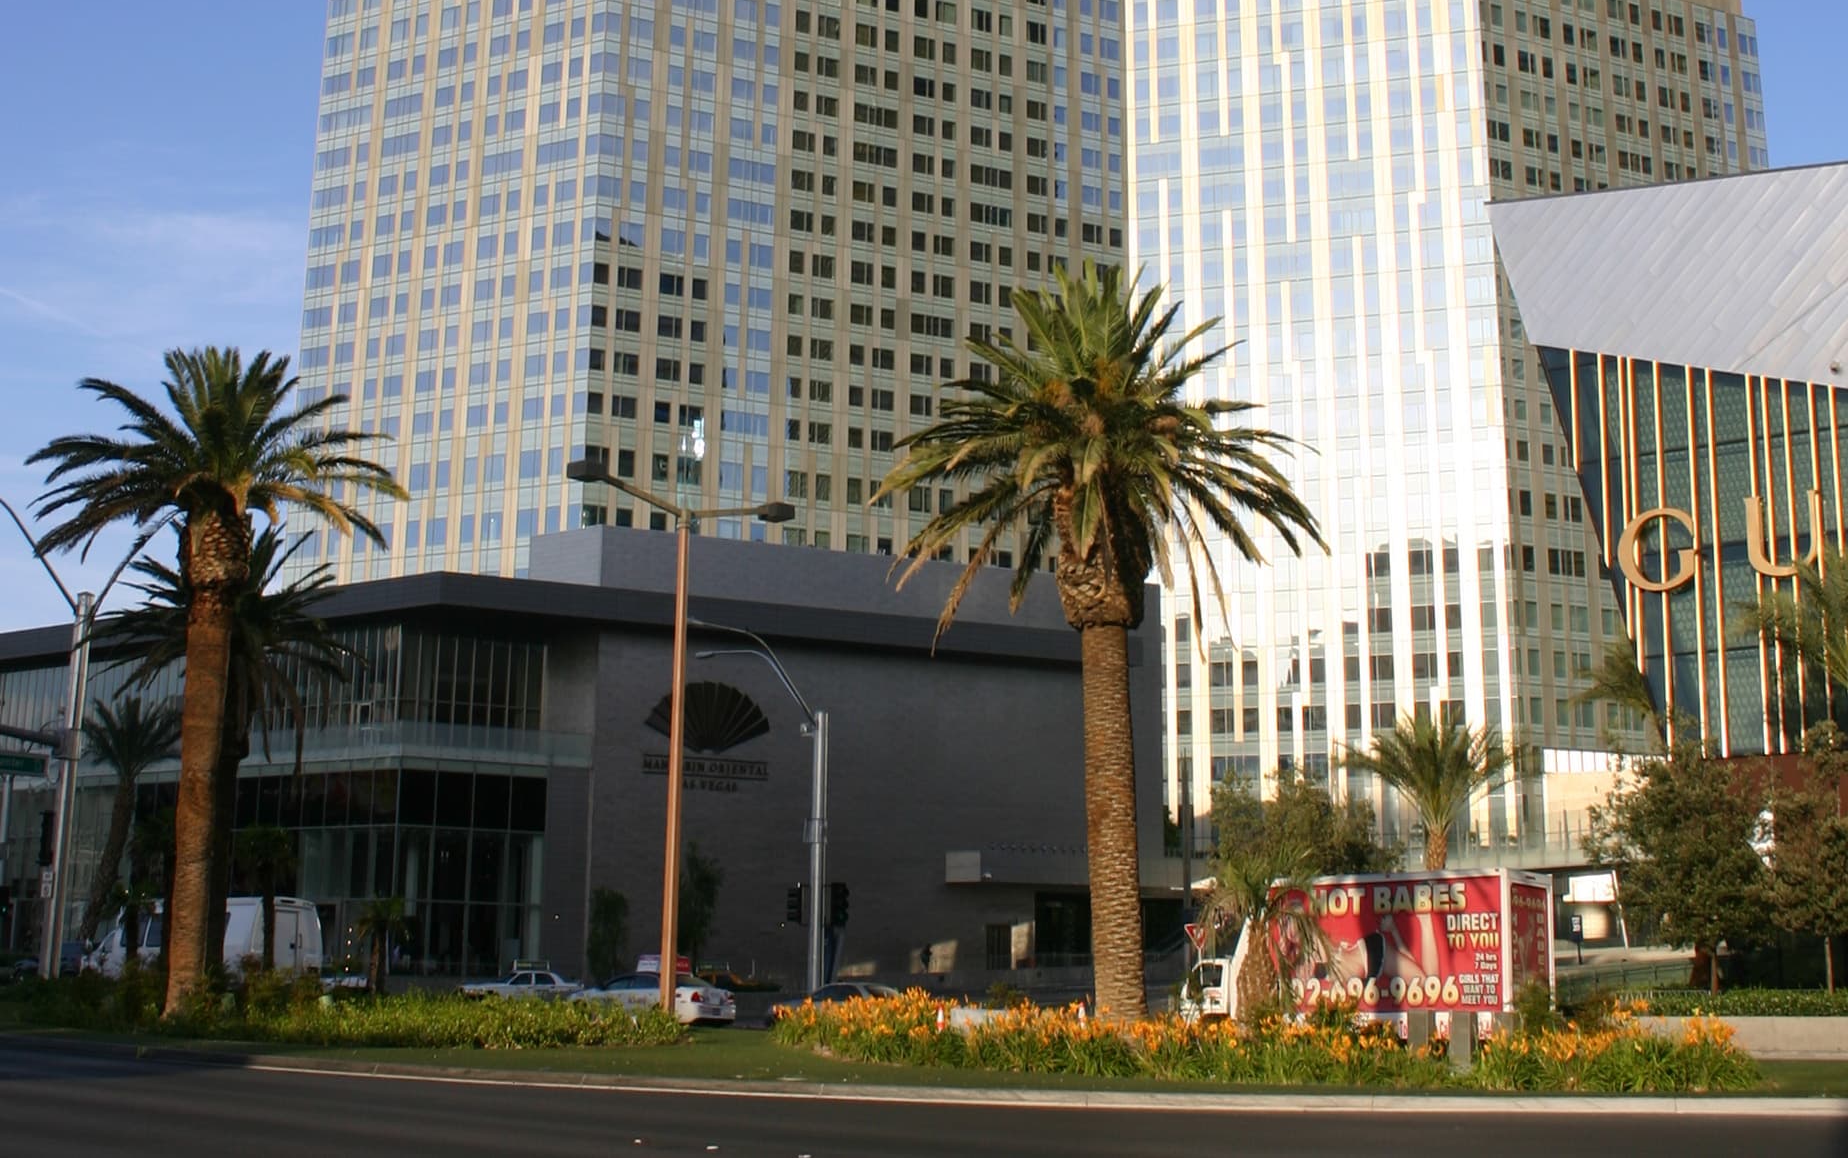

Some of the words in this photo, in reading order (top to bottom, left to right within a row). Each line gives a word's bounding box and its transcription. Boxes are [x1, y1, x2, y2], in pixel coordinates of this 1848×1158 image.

[709, 761, 769, 776] ORIENTAL
[1310, 888, 1366, 917] HOT
[1373, 882, 1467, 915] BABES
[1446, 913, 1498, 931] DIRECT
[1447, 933, 1465, 950] TO
[1469, 932, 1499, 950] YOU
[1481, 973, 1500, 984] THAT
[1463, 984, 1484, 995] WANT
[1485, 984, 1496, 995] TO
[1461, 994, 1482, 1005] MEET
[1483, 994, 1498, 1005] YOU
